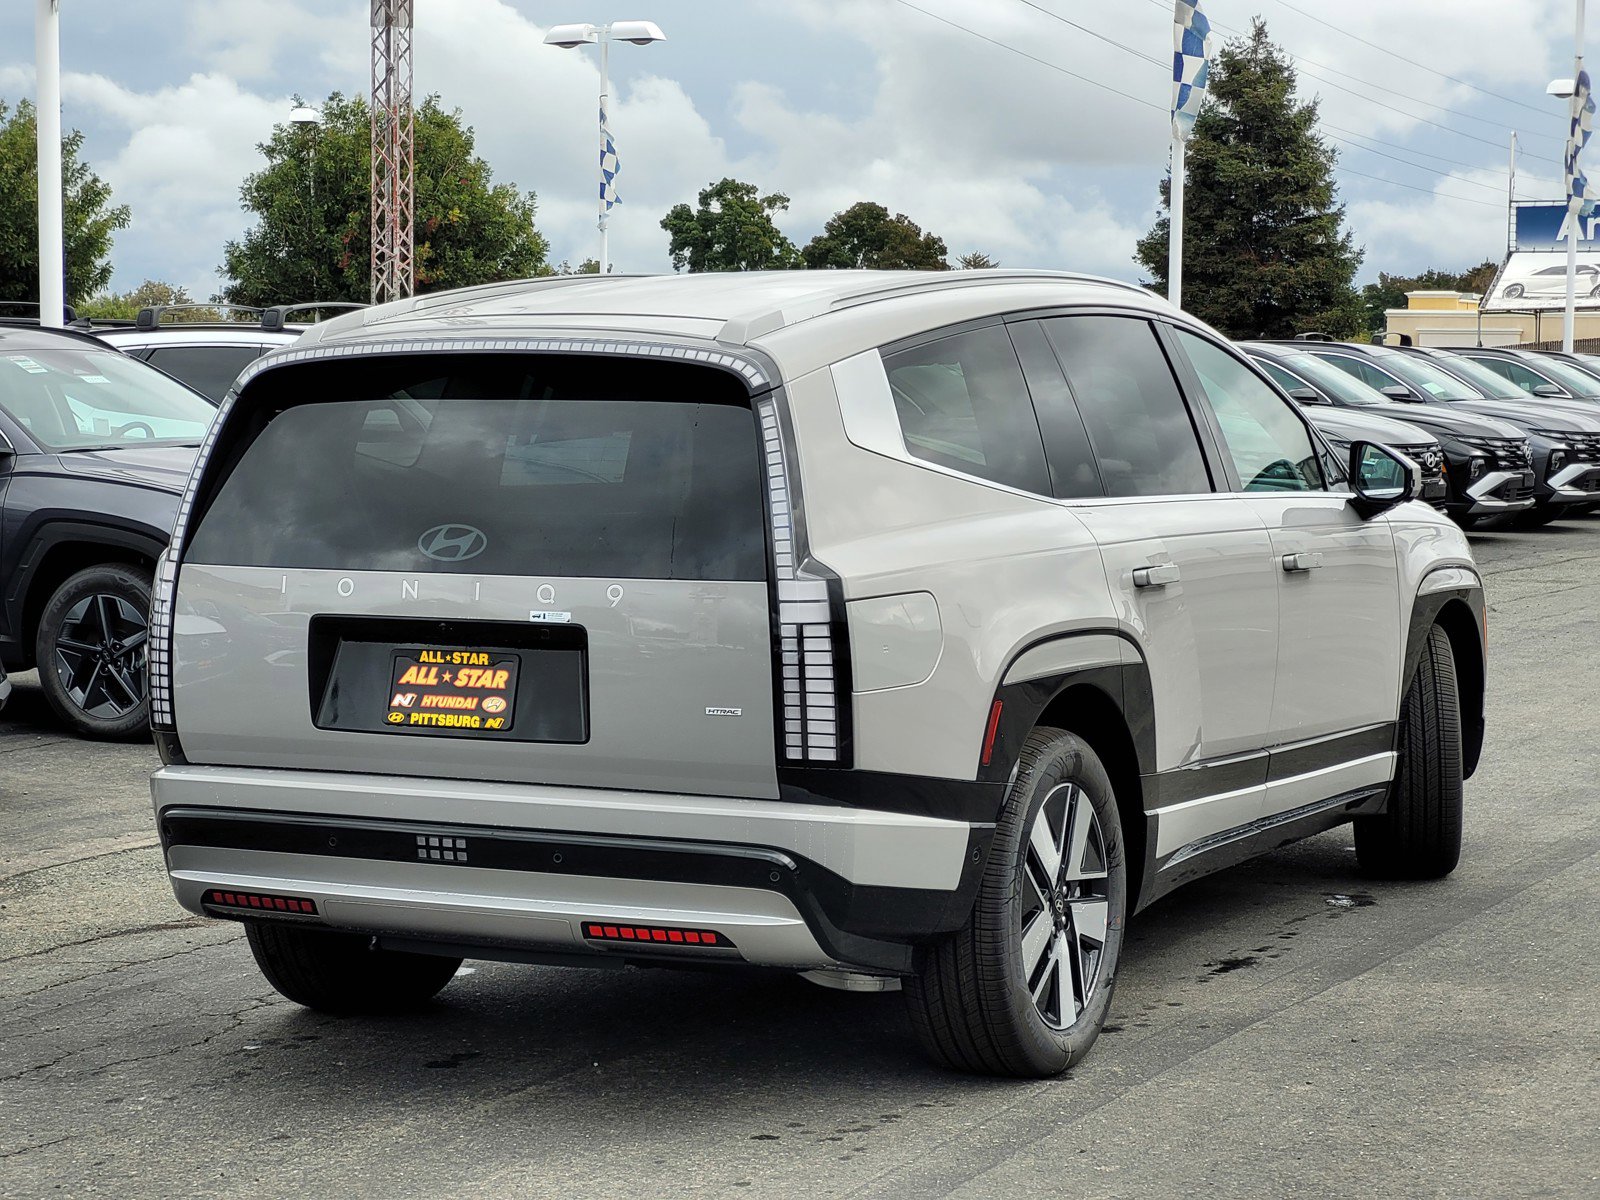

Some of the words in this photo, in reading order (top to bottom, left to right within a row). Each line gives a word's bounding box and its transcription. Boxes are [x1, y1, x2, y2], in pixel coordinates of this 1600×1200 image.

[280, 575, 556, 604] IONIQ
[606, 583, 624, 608] 9
[419, 651, 445, 663] ALL
[452, 652, 489, 665] STAR
[398, 665, 439, 685] ALL
[453, 667, 510, 689] STAR
[420, 694, 479, 710] HYUNDAI
[410, 713, 481, 728] PITTSBURG
